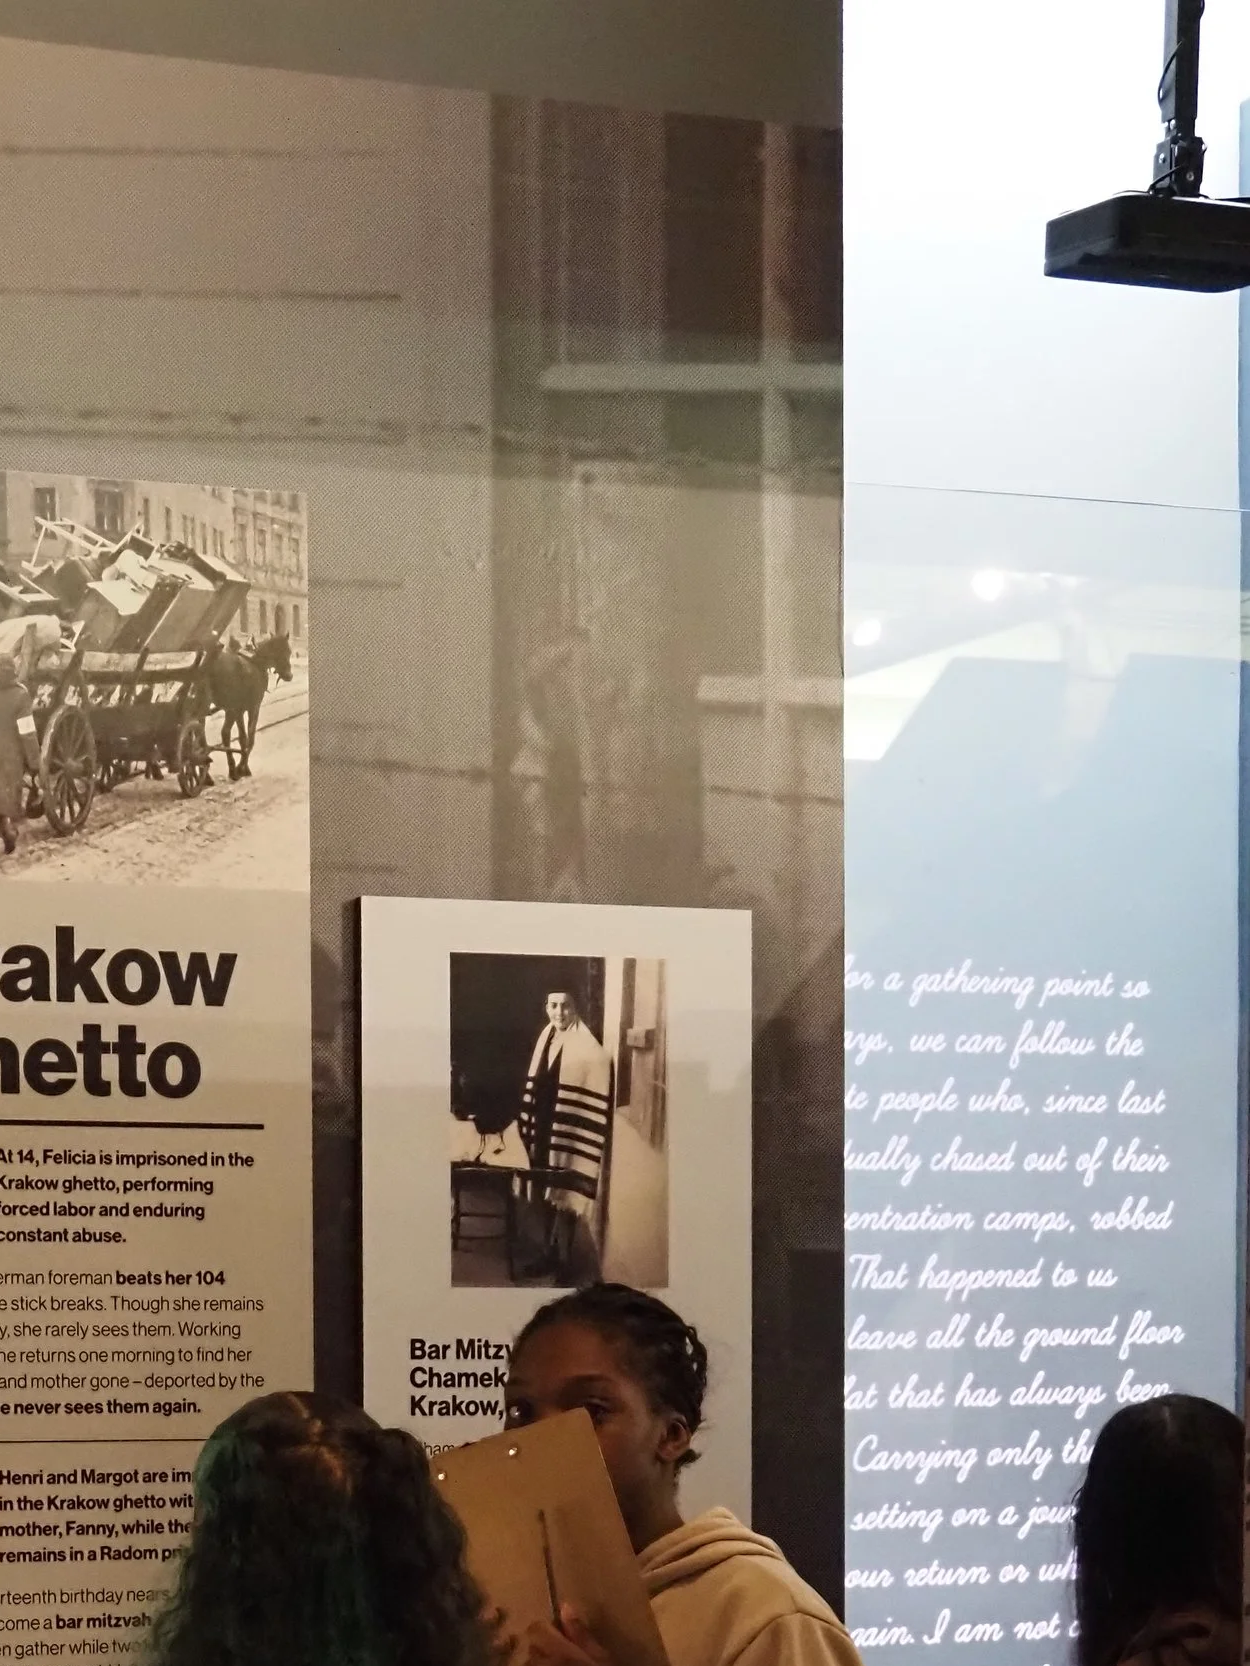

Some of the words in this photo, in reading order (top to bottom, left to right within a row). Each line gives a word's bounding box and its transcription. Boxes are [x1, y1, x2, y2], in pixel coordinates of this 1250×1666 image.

[909, 959, 1035, 1009] gathering
[1039, 969, 1114, 1007] point
[955, 1031, 1007, 1053] can
[1009, 1020, 1095, 1069] follow
[1105, 1022, 1144, 1057] the
[873, 1077, 959, 1123] people
[969, 1078, 1031, 1115] who,
[1043, 1085, 1107, 1113] since
[1118, 1080, 1167, 1114] last
[17, 1149, 39, 1167] 14,
[43, 1149, 96, 1165] Felicia
[99, 1150, 113, 1165] is
[116, 1150, 208, 1169] imprisoned
[211, 1152, 225, 1167] in
[228, 1152, 254, 1168] the
[929, 1135, 1017, 1172] chased
[1024, 1145, 1069, 1171] out
[1075, 1136, 1108, 1187] of
[1112, 1137, 1170, 1172] their
[62, 1175, 120, 1194] ghetto,
[123, 1176, 214, 1196] performing
[53, 1201, 96, 1217] labor
[99, 1202, 130, 1217] and
[133, 1202, 205, 1222] enduring
[983, 1209, 1075, 1242] camps,
[1091, 1196, 1174, 1231] robbed
[72, 1227, 126, 1243] abuse.
[48, 1269, 112, 1287] foreman
[115, 1270, 162, 1286] beats
[164, 1270, 192, 1286] her
[195, 1270, 226, 1288] 104
[849, 1253, 909, 1289] That
[918, 1253, 1044, 1302] happened
[9, 1295, 47, 1311] stick
[50, 1296, 106, 1312] breaks.
[110, 1295, 170, 1316] Though
[172, 1296, 202, 1312] she
[204, 1296, 264, 1312] remains
[13, 1321, 42, 1338] she
[45, 1321, 89, 1341] rarely
[92, 1324, 129, 1338] sees
[132, 1321, 175, 1337] them.
[178, 1320, 241, 1341] Working
[847, 1315, 917, 1349] leave
[926, 1313, 966, 1348] all
[975, 1313, 1015, 1348] the
[1020, 1315, 1118, 1361] ground
[1119, 1310, 1186, 1359] floor
[19, 1347, 76, 1364] returns
[79, 1351, 108, 1364] one
[111, 1347, 175, 1367] morning
[196, 1346, 224, 1363] find
[227, 1346, 252, 1362] her
[410, 1338, 451, 1360] Bar
[31, 1373, 87, 1391] mother
[90, 1376, 130, 1392] gone
[145, 1373, 216, 1390] deported
[240, 1373, 265, 1387] the
[888, 1374, 945, 1408] that
[955, 1373, 1002, 1408] has
[1010, 1371, 1105, 1419] always
[14, 1403, 61, 1415] never
[64, 1402, 104, 1415] sees
[106, 1398, 149, 1414] them
[152, 1398, 201, 1417] again.
[410, 1394, 504, 1421] Krakow,
[853, 1434, 977, 1484] Carrying
[986, 1430, 1053, 1480] only
[46, 1469, 78, 1485] and
[81, 1468, 139, 1488] Margot
[142, 1471, 169, 1484] are
[16, 1495, 44, 1511] the
[47, 1494, 110, 1511] Krakow
[113, 1493, 166, 1514] ghetto
[65, 1520, 119, 1539] Fanny,
[121, 1519, 165, 1536] while
[850, 1501, 943, 1542] setting
[0, 1547, 67, 1563] remains
[100, 1545, 159, 1562] Radom
[905, 1559, 991, 1586] return
[59, 1587, 124, 1607] birthday
[54, 1613, 84, 1632] bar
[1014, 1613, 1061, 1642] not
[13, 1640, 67, 1661] gather
[68, 1636, 111, 1656] while
